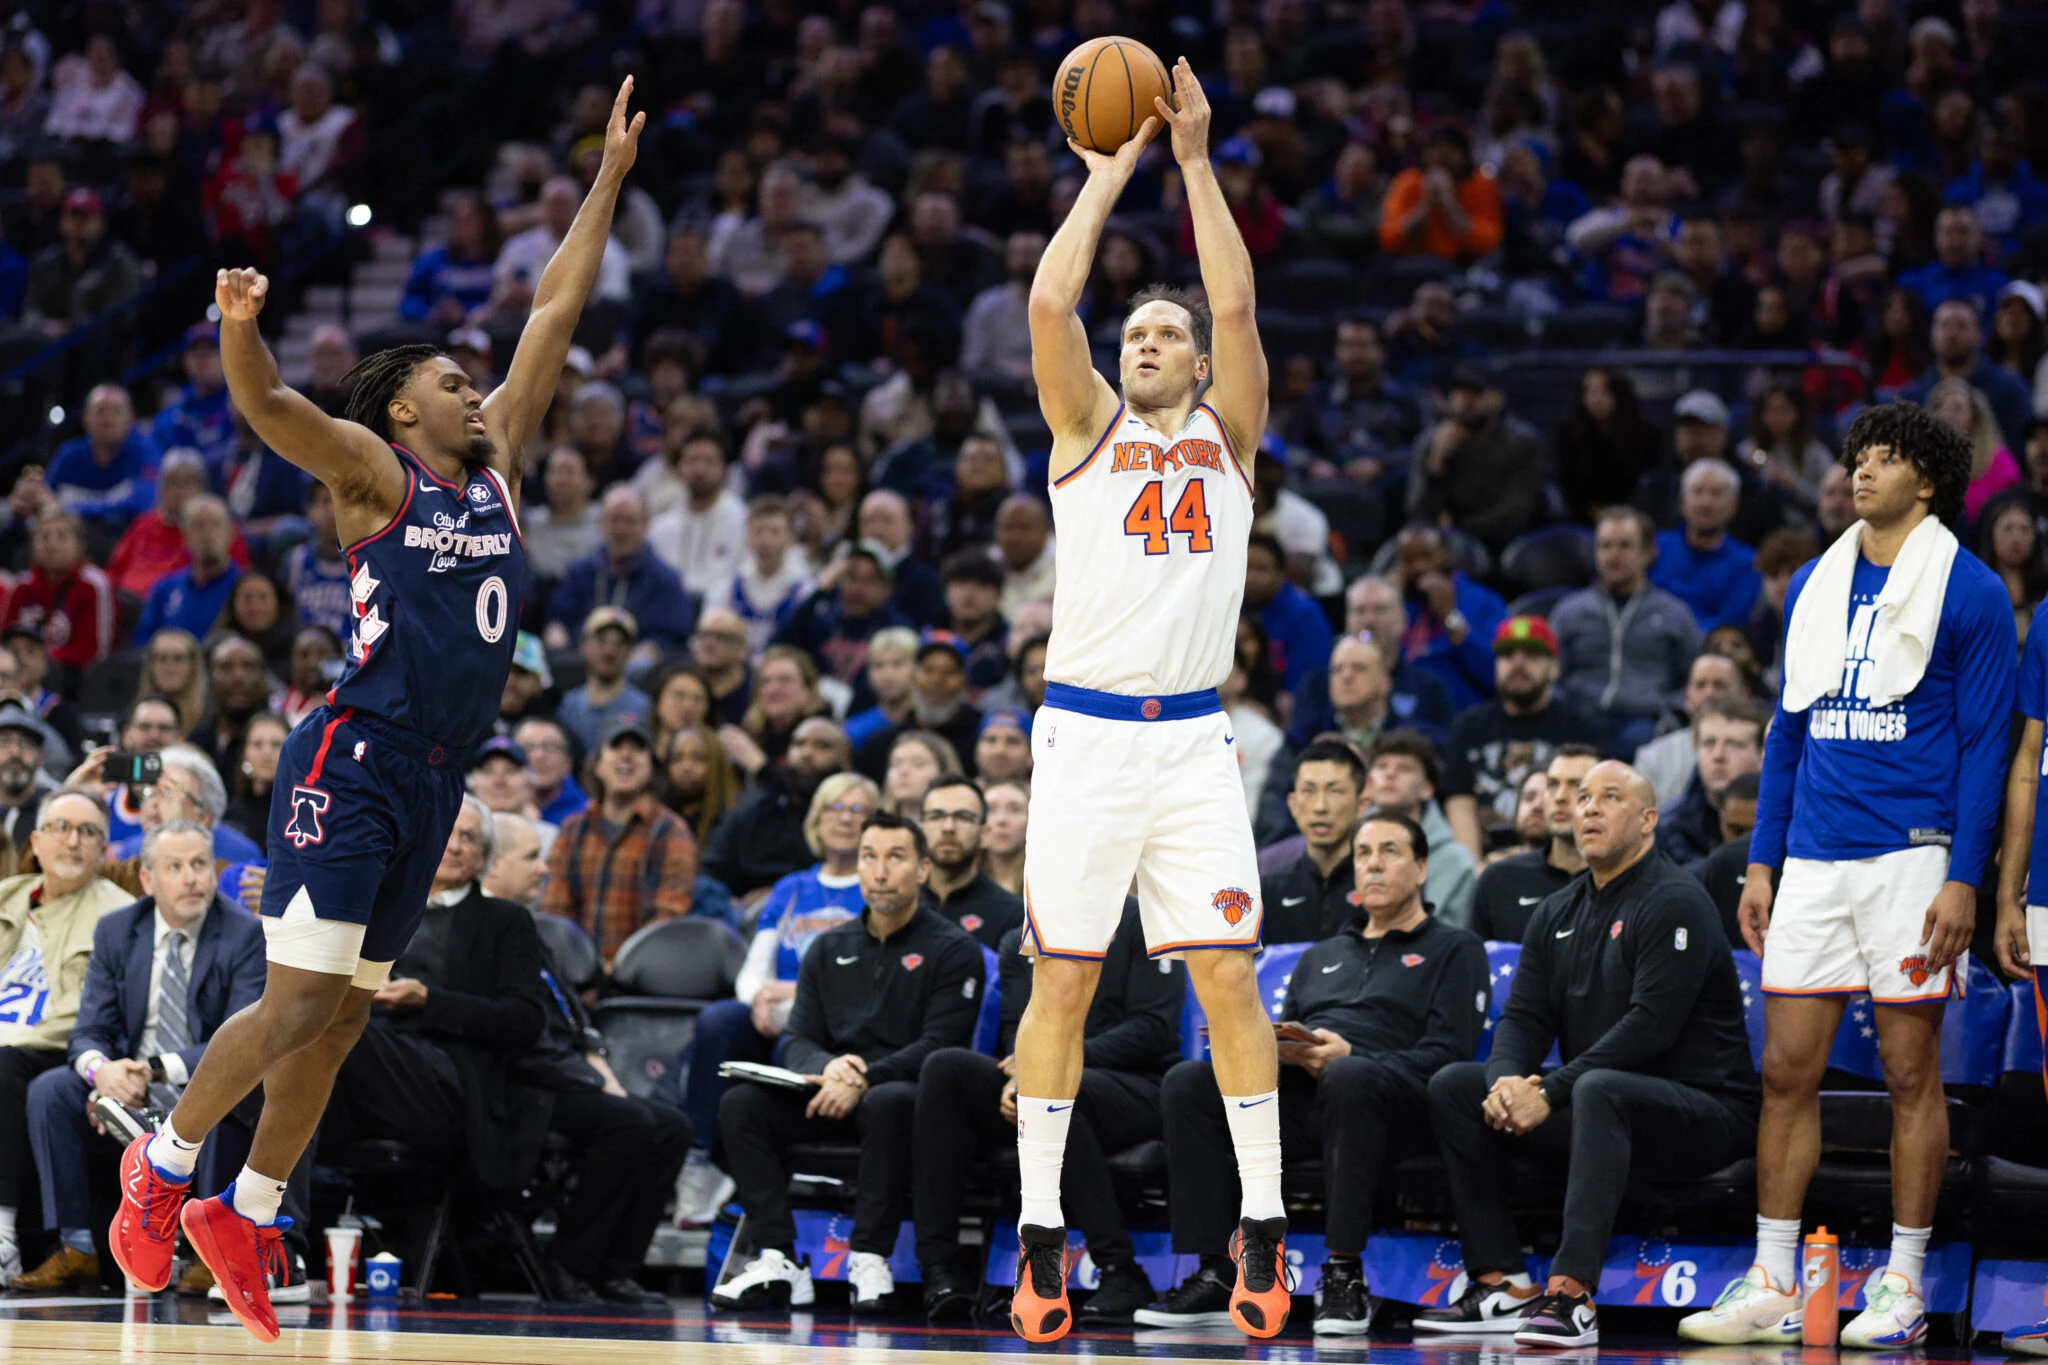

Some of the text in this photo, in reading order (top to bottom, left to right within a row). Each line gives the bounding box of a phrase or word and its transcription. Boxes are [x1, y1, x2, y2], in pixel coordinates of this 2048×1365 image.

[1061, 66, 1086, 141] Wilson
[1110, 438, 1226, 476] NEW YORK
[433, 511, 470, 531] City of
[1123, 478, 1213, 556] 44
[404, 525, 512, 558] BROTHERLY
[427, 550, 457, 573] Love
[475, 575, 508, 643] 0
[1848, 709, 1907, 742] VOICES
[0, 981, 49, 1026] 21
[1633, 1260, 1698, 1307] 76
